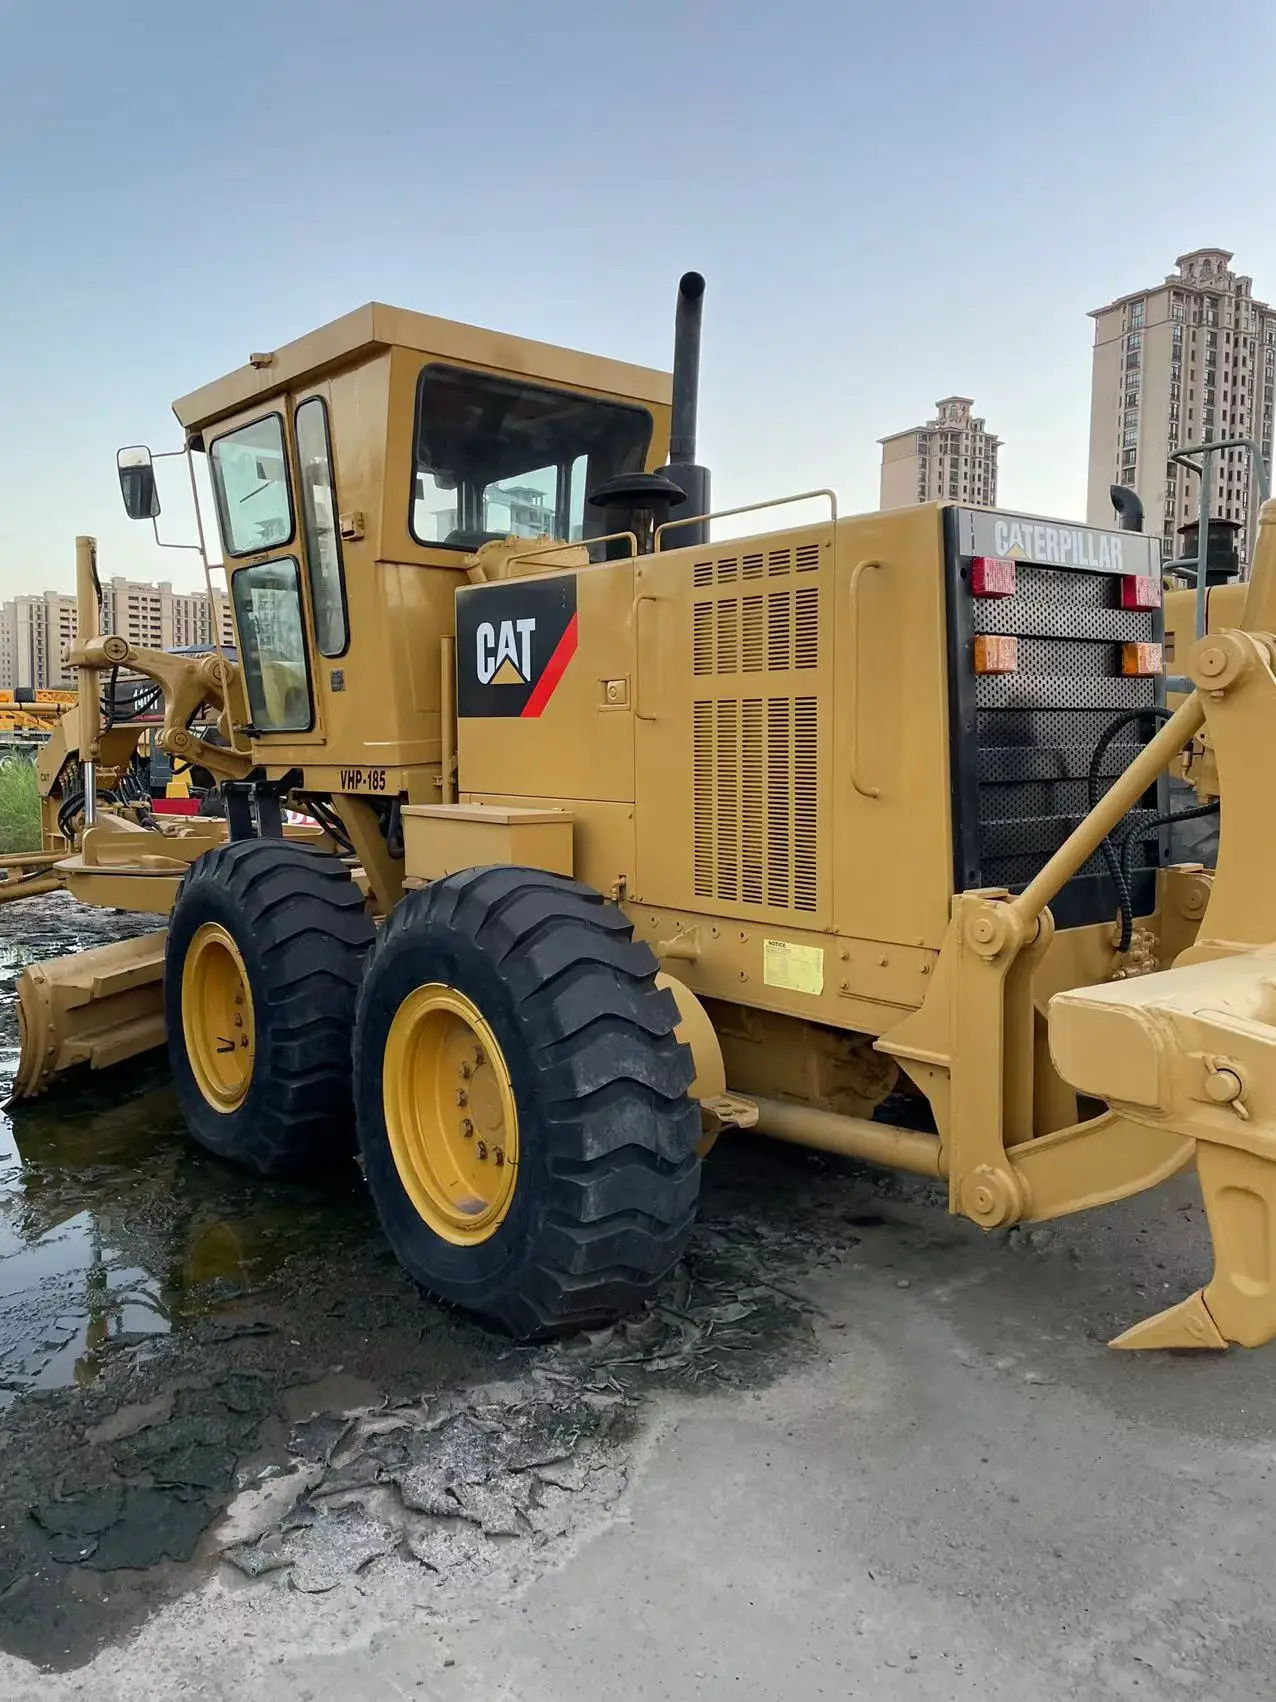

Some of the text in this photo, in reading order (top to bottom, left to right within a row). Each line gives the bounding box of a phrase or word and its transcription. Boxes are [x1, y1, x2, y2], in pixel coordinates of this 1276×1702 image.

[994, 520, 1122, 569] CATERPILLAR
[476, 618, 536, 685] CAT
[340, 769, 386, 791] VHP-185
